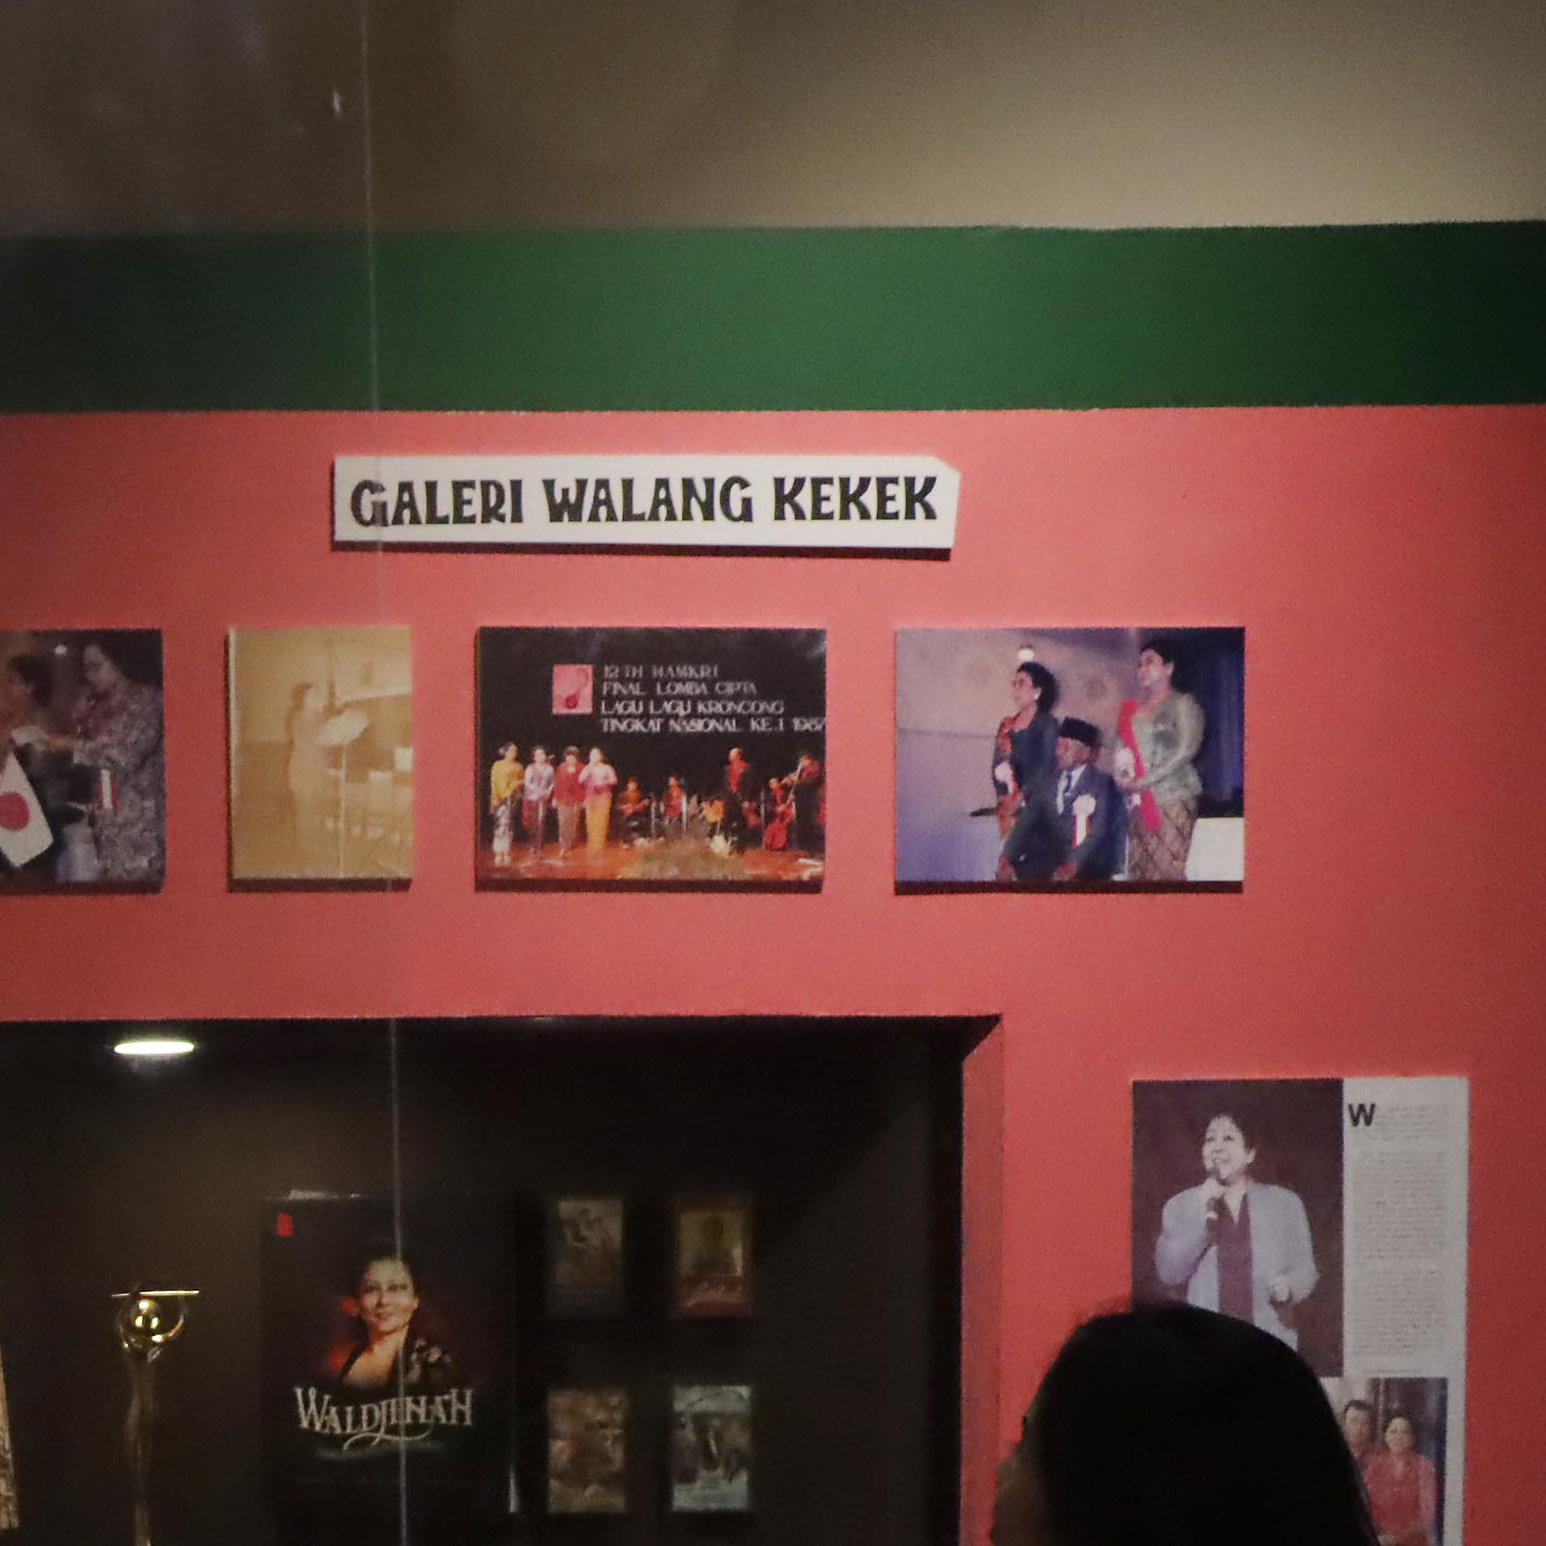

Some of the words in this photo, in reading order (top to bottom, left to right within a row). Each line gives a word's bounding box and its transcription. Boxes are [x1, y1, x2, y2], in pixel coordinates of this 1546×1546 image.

[350, 478, 524, 528] GALERI
[541, 476, 754, 525] WALANG
[772, 475, 940, 522] KEKEK
[602, 681, 647, 696] FINAL
[656, 681, 709, 696] LOMBA
[715, 682, 758, 695] CIPTA
[600, 700, 644, 715] LAGU
[649, 700, 693, 716] LAGU
[697, 700, 785, 715] KRONCONG
[601, 717, 664, 733] TINGKAT
[669, 718, 743, 733] NASIONAL
[1347, 1102, 1377, 1128] W
